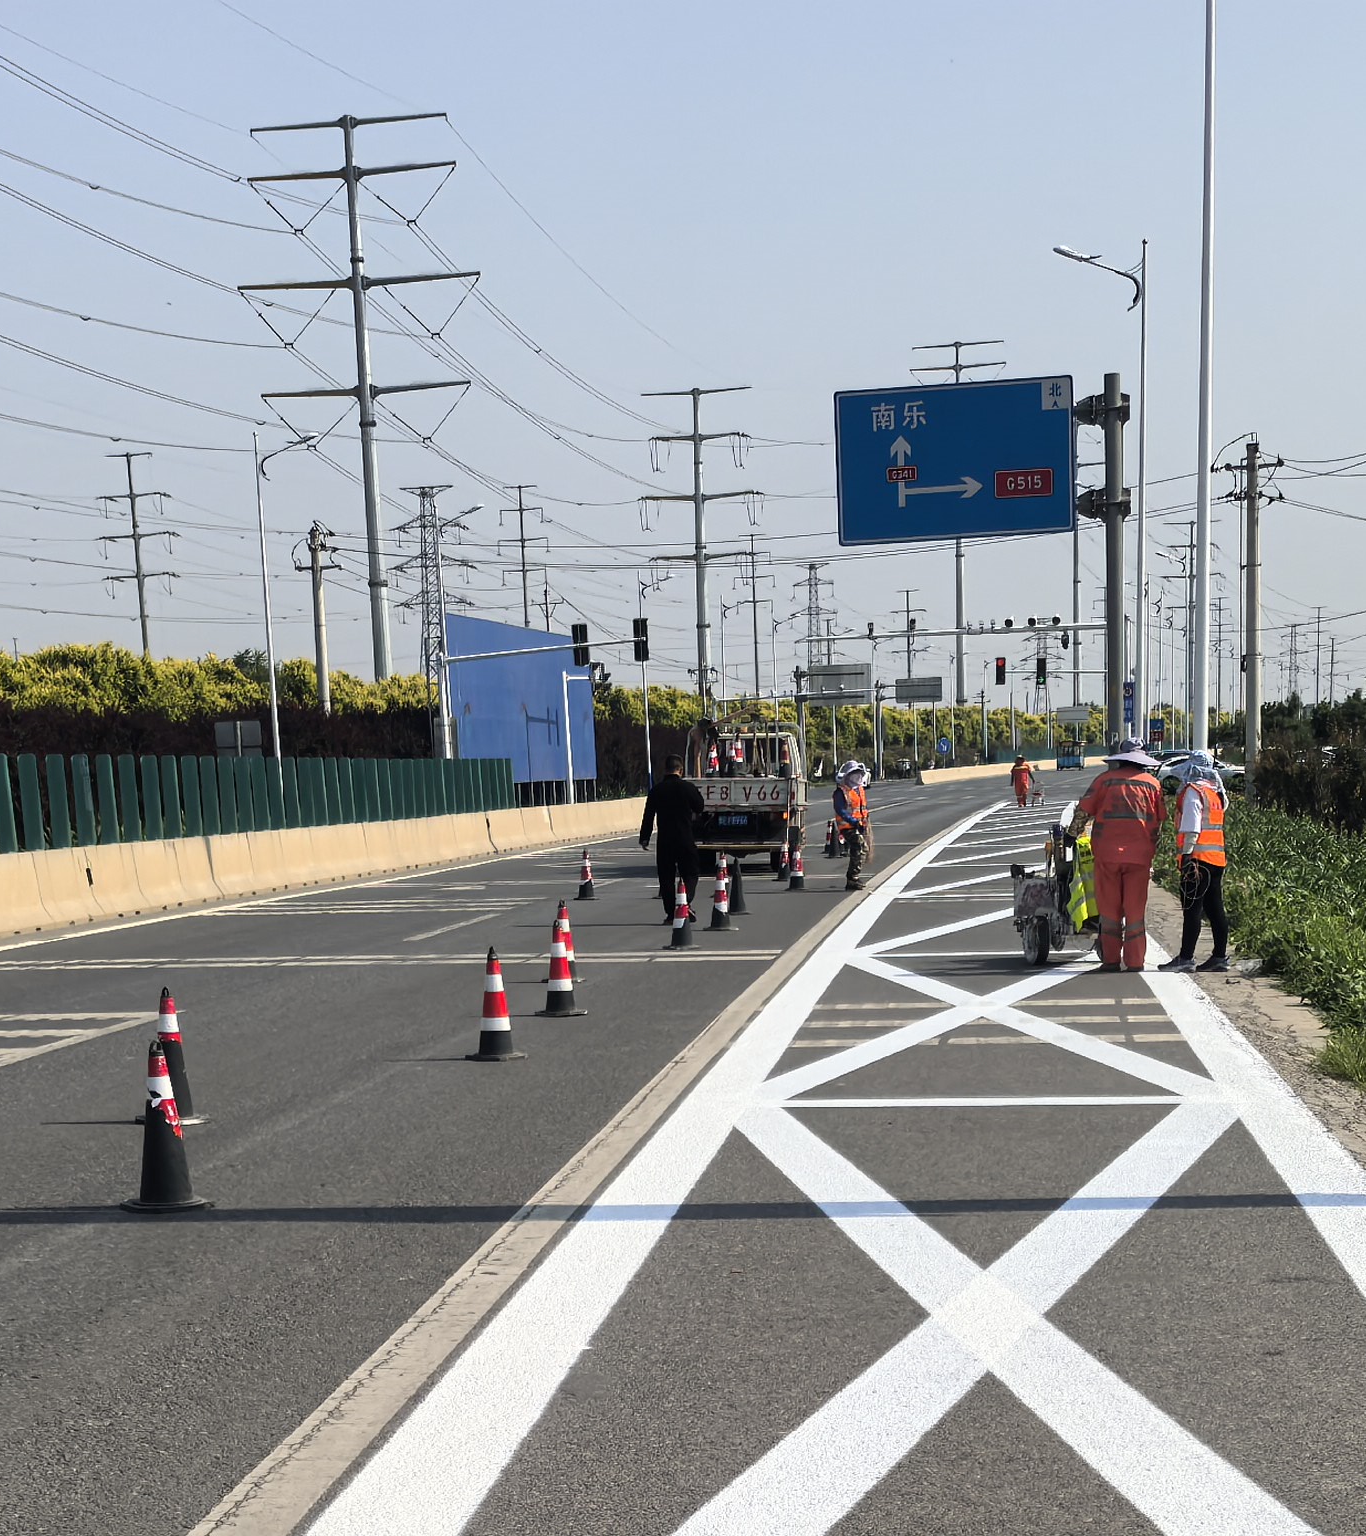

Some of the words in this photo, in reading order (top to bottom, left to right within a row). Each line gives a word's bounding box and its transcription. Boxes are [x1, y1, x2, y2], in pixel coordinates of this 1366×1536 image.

[1048, 382, 1062, 397] 北
[870, 400, 927, 432] 南乐
[1006, 475, 1042, 491] G515
[743, 784, 780, 802] V66
